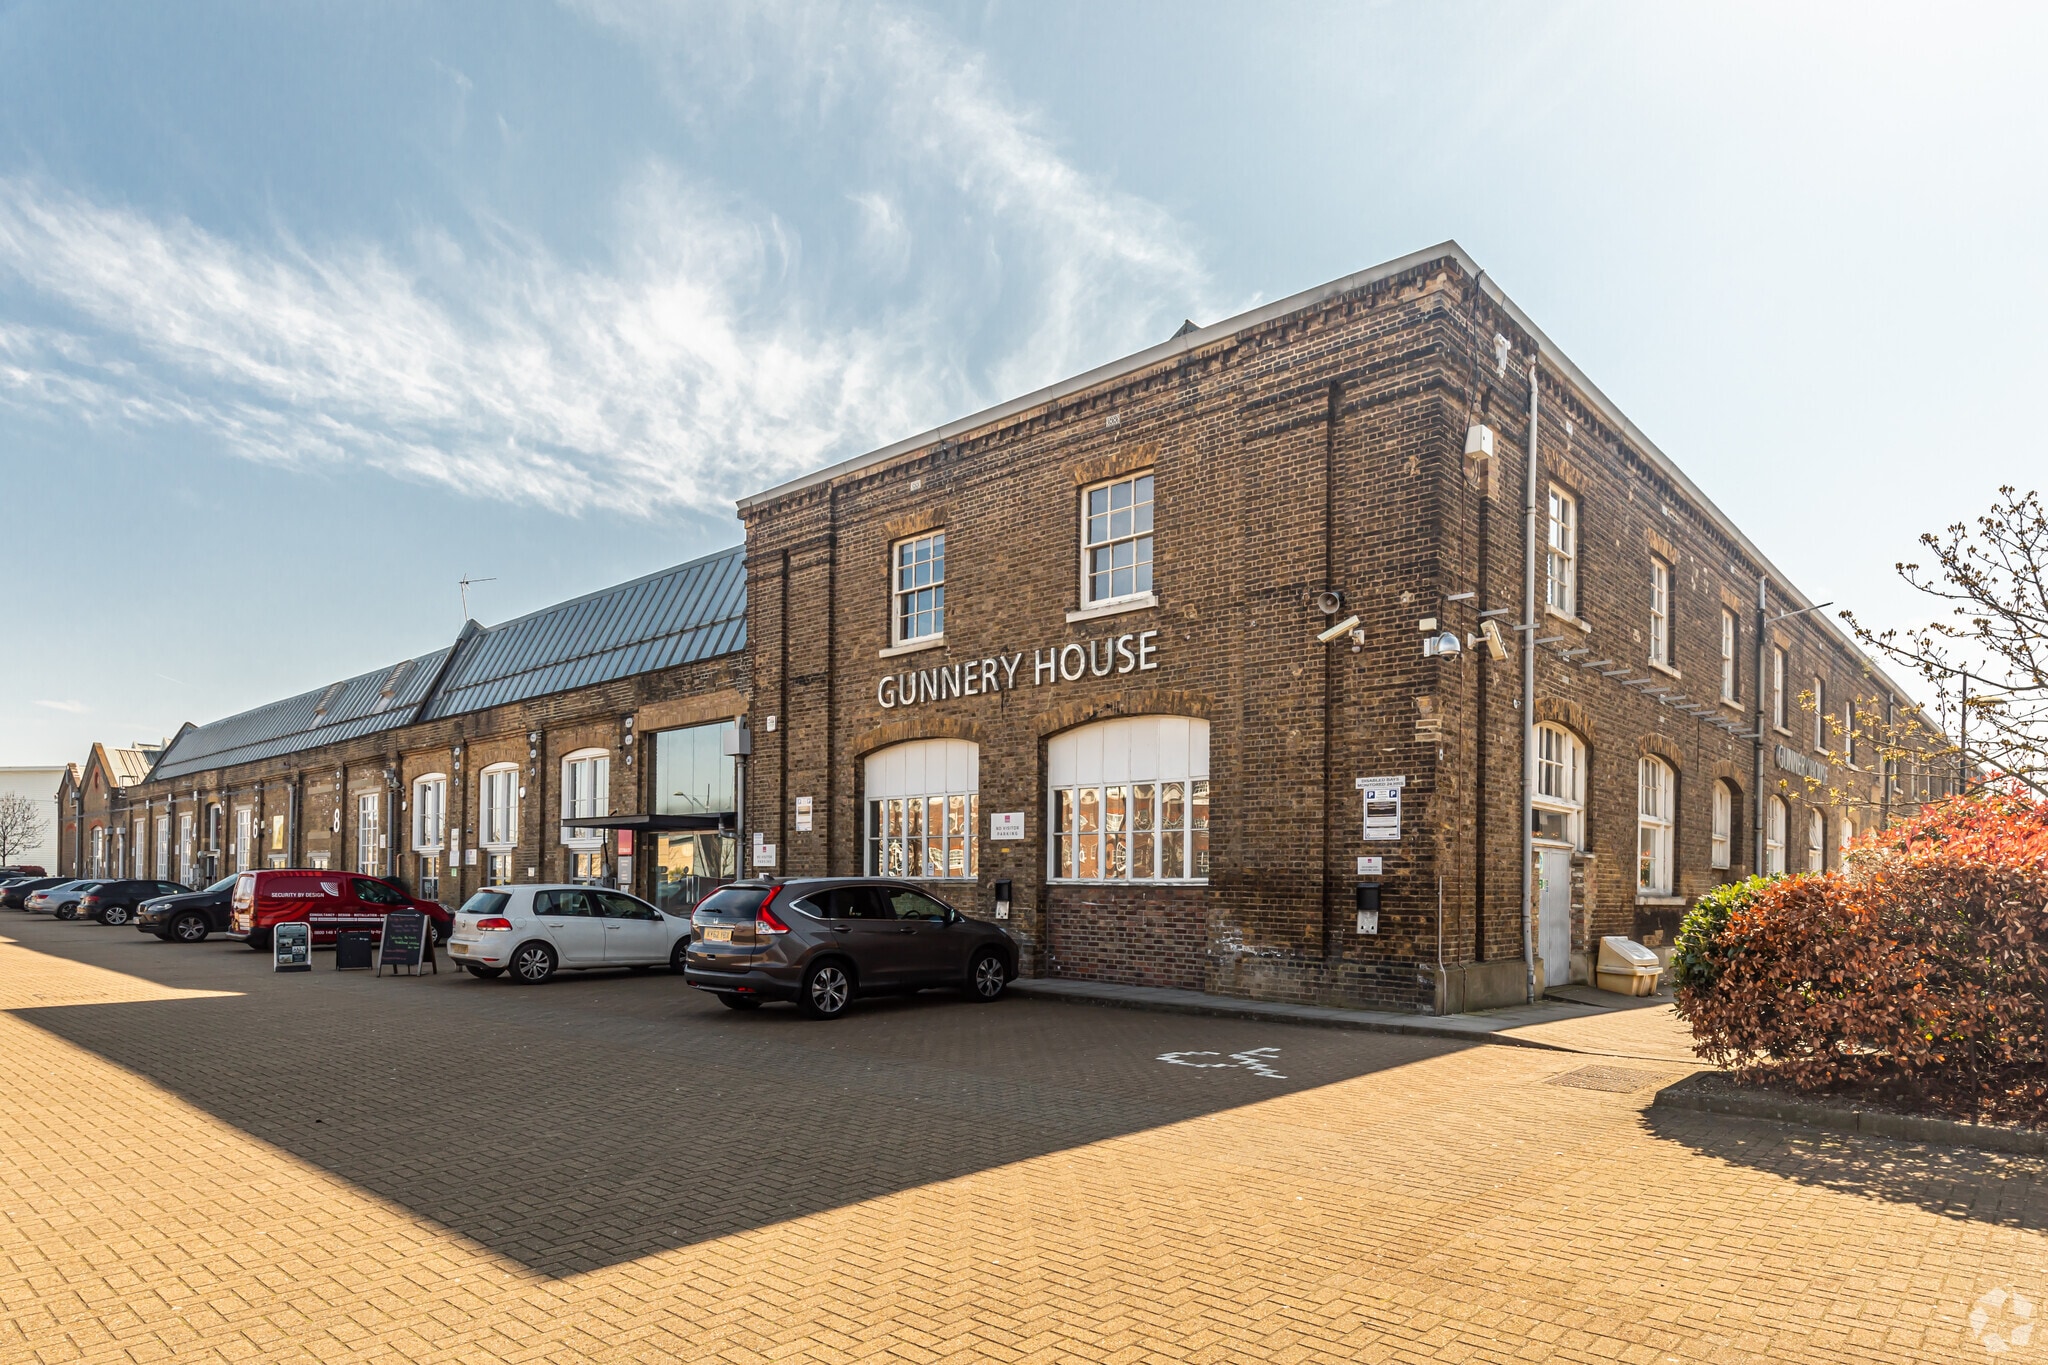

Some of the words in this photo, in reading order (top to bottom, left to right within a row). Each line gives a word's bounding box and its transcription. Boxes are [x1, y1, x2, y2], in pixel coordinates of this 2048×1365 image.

[877, 652, 1023, 709] GUNNERY
[1034, 630, 1159, 686] HOUSE
[252, 817, 258, 839] 6
[333, 808, 340, 833] 8
